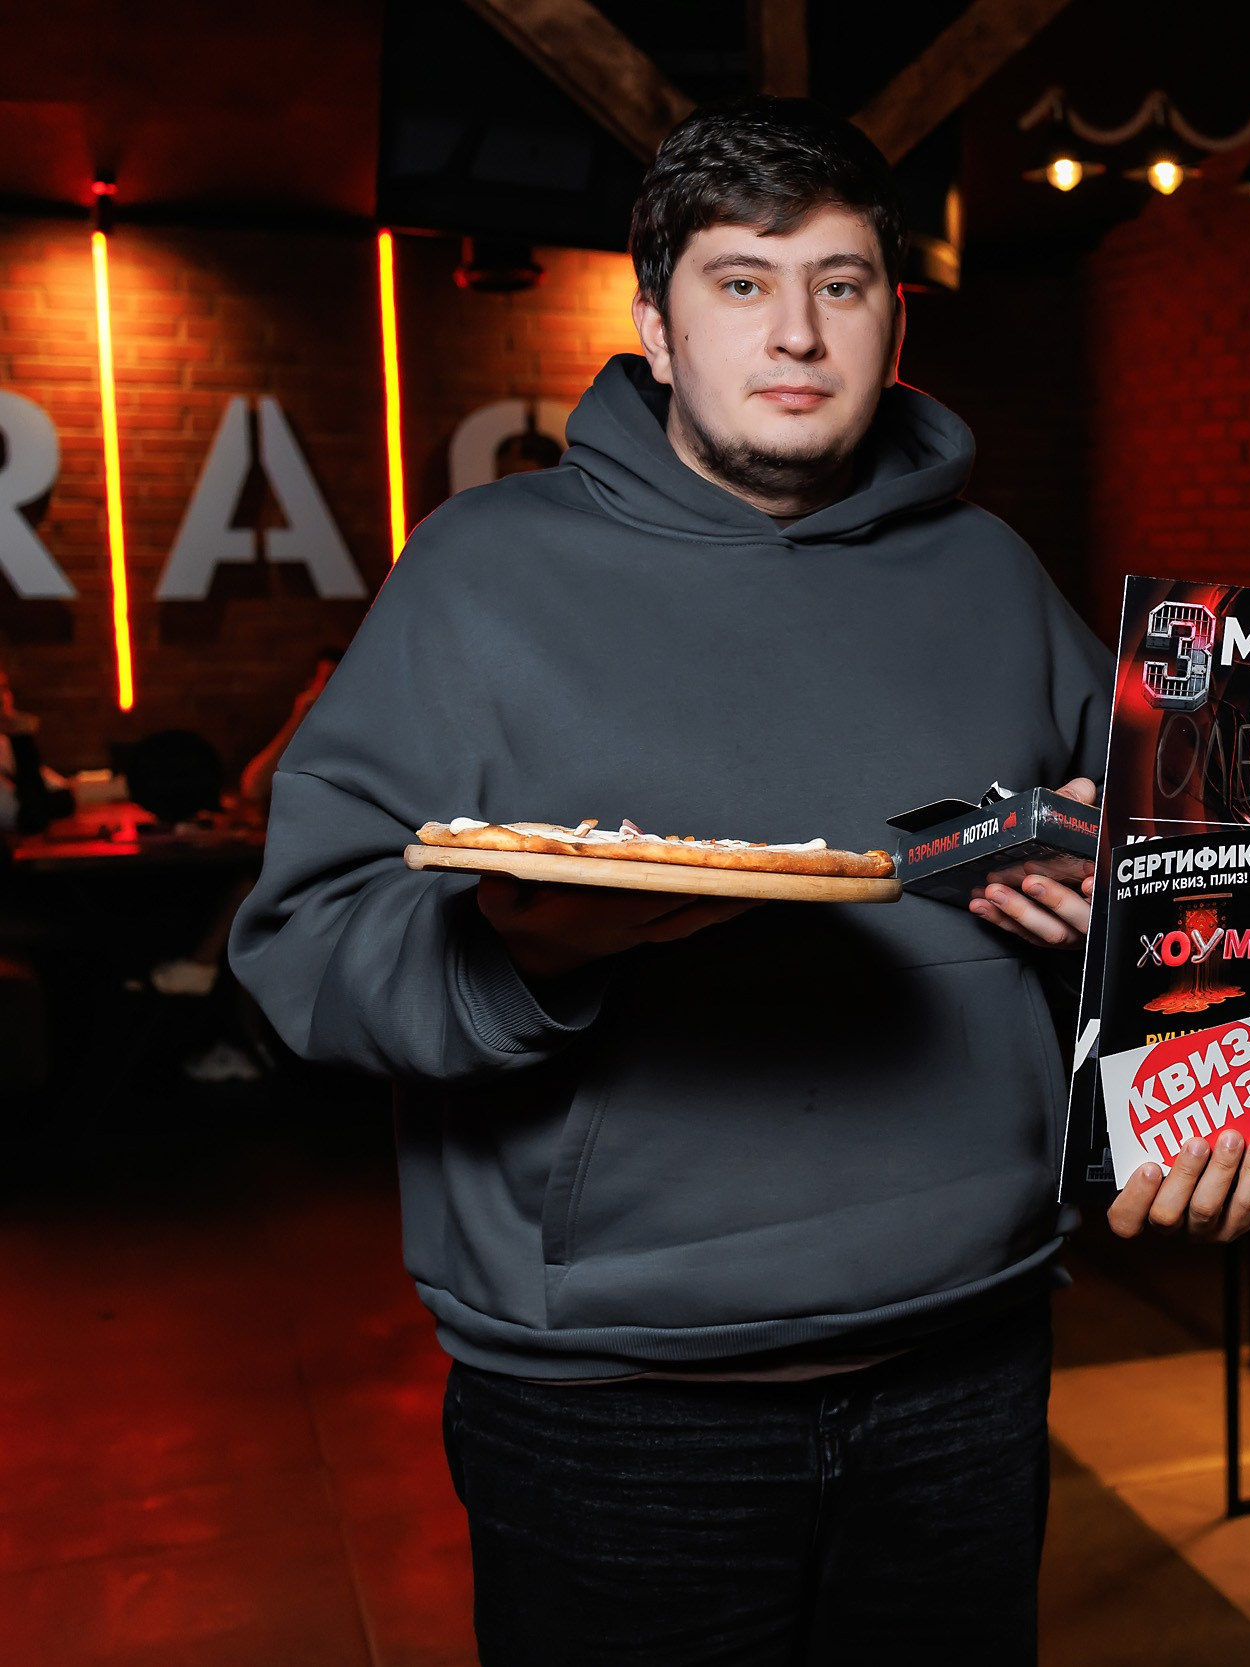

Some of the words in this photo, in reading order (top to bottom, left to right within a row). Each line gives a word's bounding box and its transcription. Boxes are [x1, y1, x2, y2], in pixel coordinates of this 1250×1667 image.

[1142, 600, 1216, 711] 3
[908, 831, 961, 865] ВЗРЫВНЫЕ
[963, 817, 999, 846] КОТЯТА
[1117, 886, 1131, 901] НА
[1133, 884, 1140, 896] 1
[1141, 879, 1169, 895] ИГРУ
[1172, 875, 1207, 890] КВИЗ,
[1210, 873, 1248, 886] ПЛИЗ!
